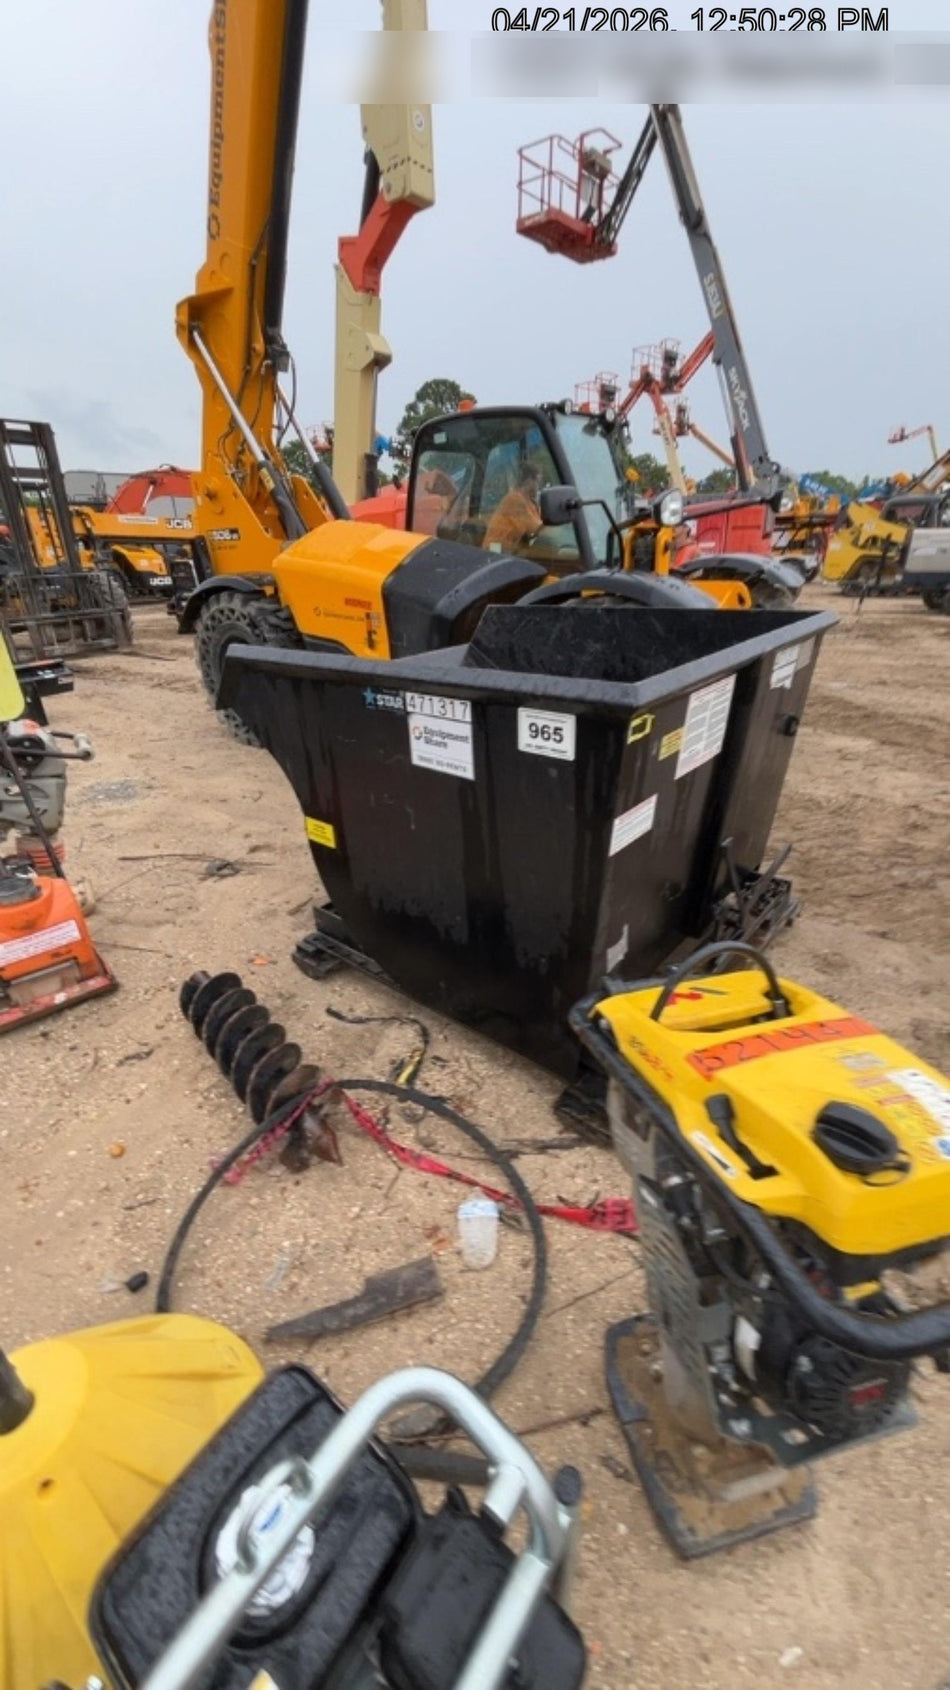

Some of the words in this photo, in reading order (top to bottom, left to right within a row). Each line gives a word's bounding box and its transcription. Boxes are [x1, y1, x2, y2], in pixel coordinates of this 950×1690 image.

[166, 519, 193, 529] JCB
[149, 577, 173, 586] JCB
[408, 694, 470, 719] 471317
[423, 725, 470, 743] Equipment
[528, 722, 564, 744] 965
